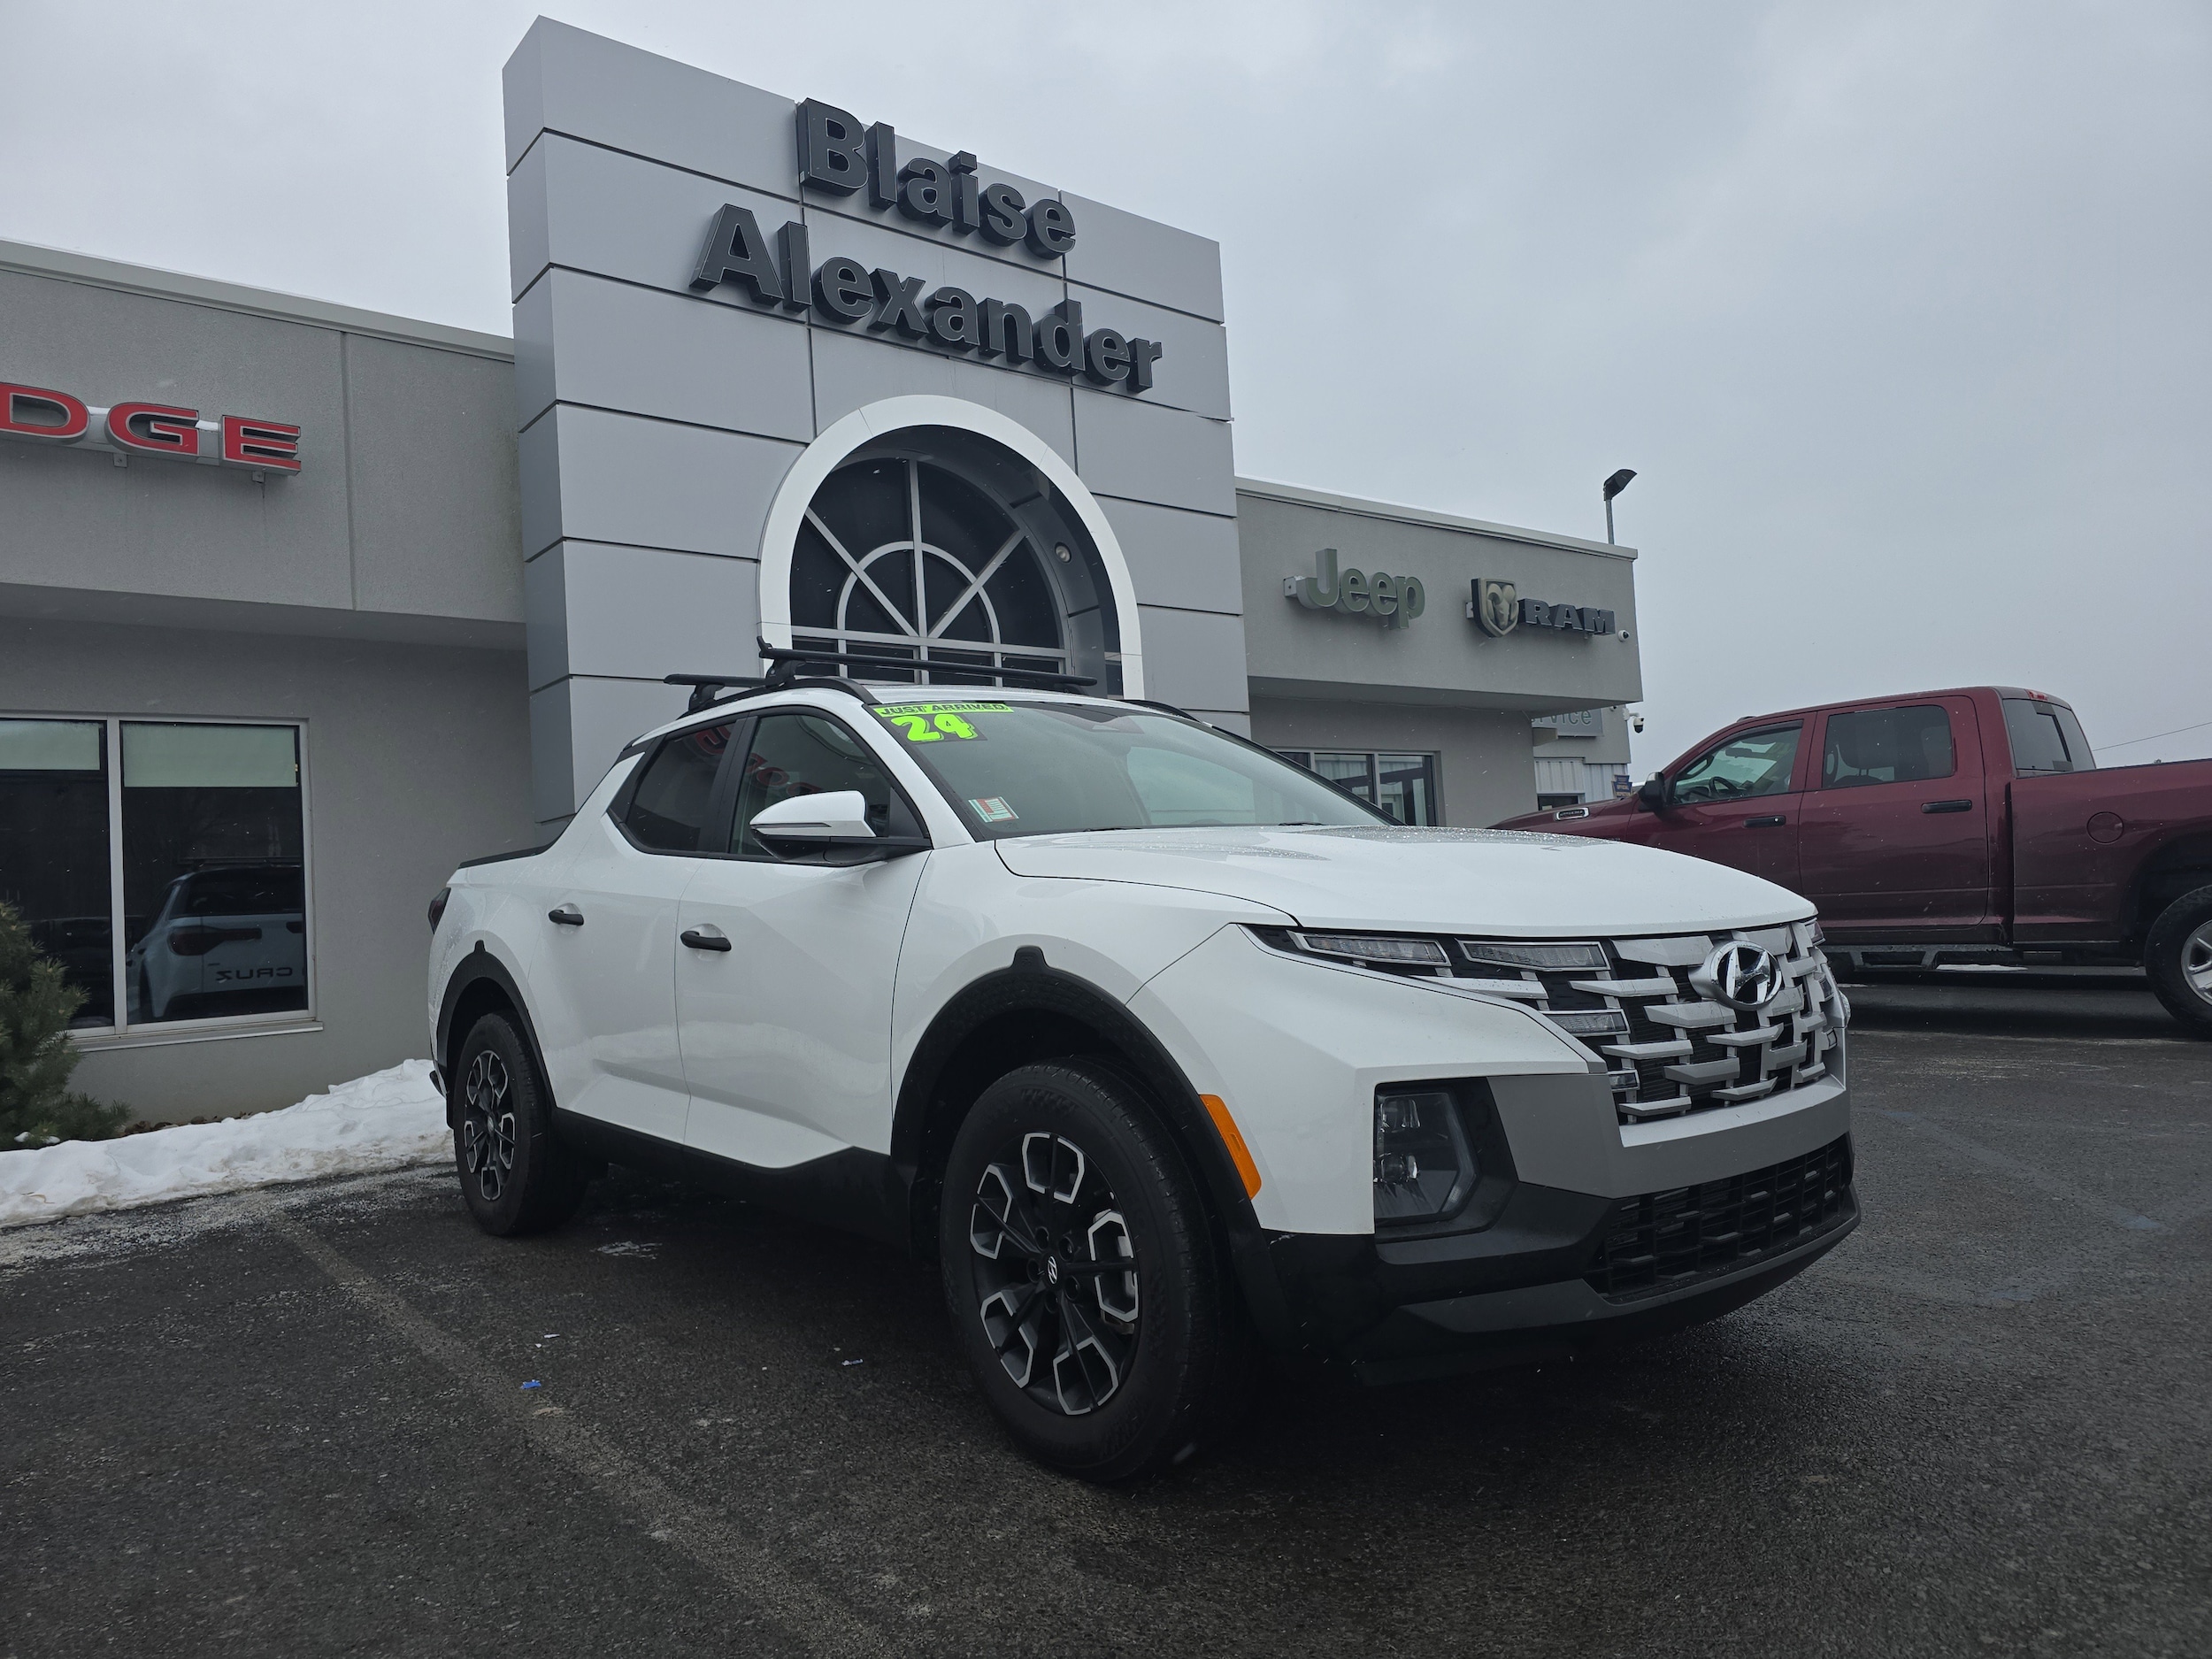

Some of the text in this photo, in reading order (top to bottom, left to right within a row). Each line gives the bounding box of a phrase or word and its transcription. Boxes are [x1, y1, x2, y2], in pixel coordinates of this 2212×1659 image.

[797, 97, 1076, 259] Blaise
[689, 204, 1162, 393] Alexander
[1296, 548, 1425, 630] Jeep
[1517, 598, 1616, 635] RAM
[881, 703, 1009, 715] JUST ARRIVED
[890, 713, 978, 741] 24
